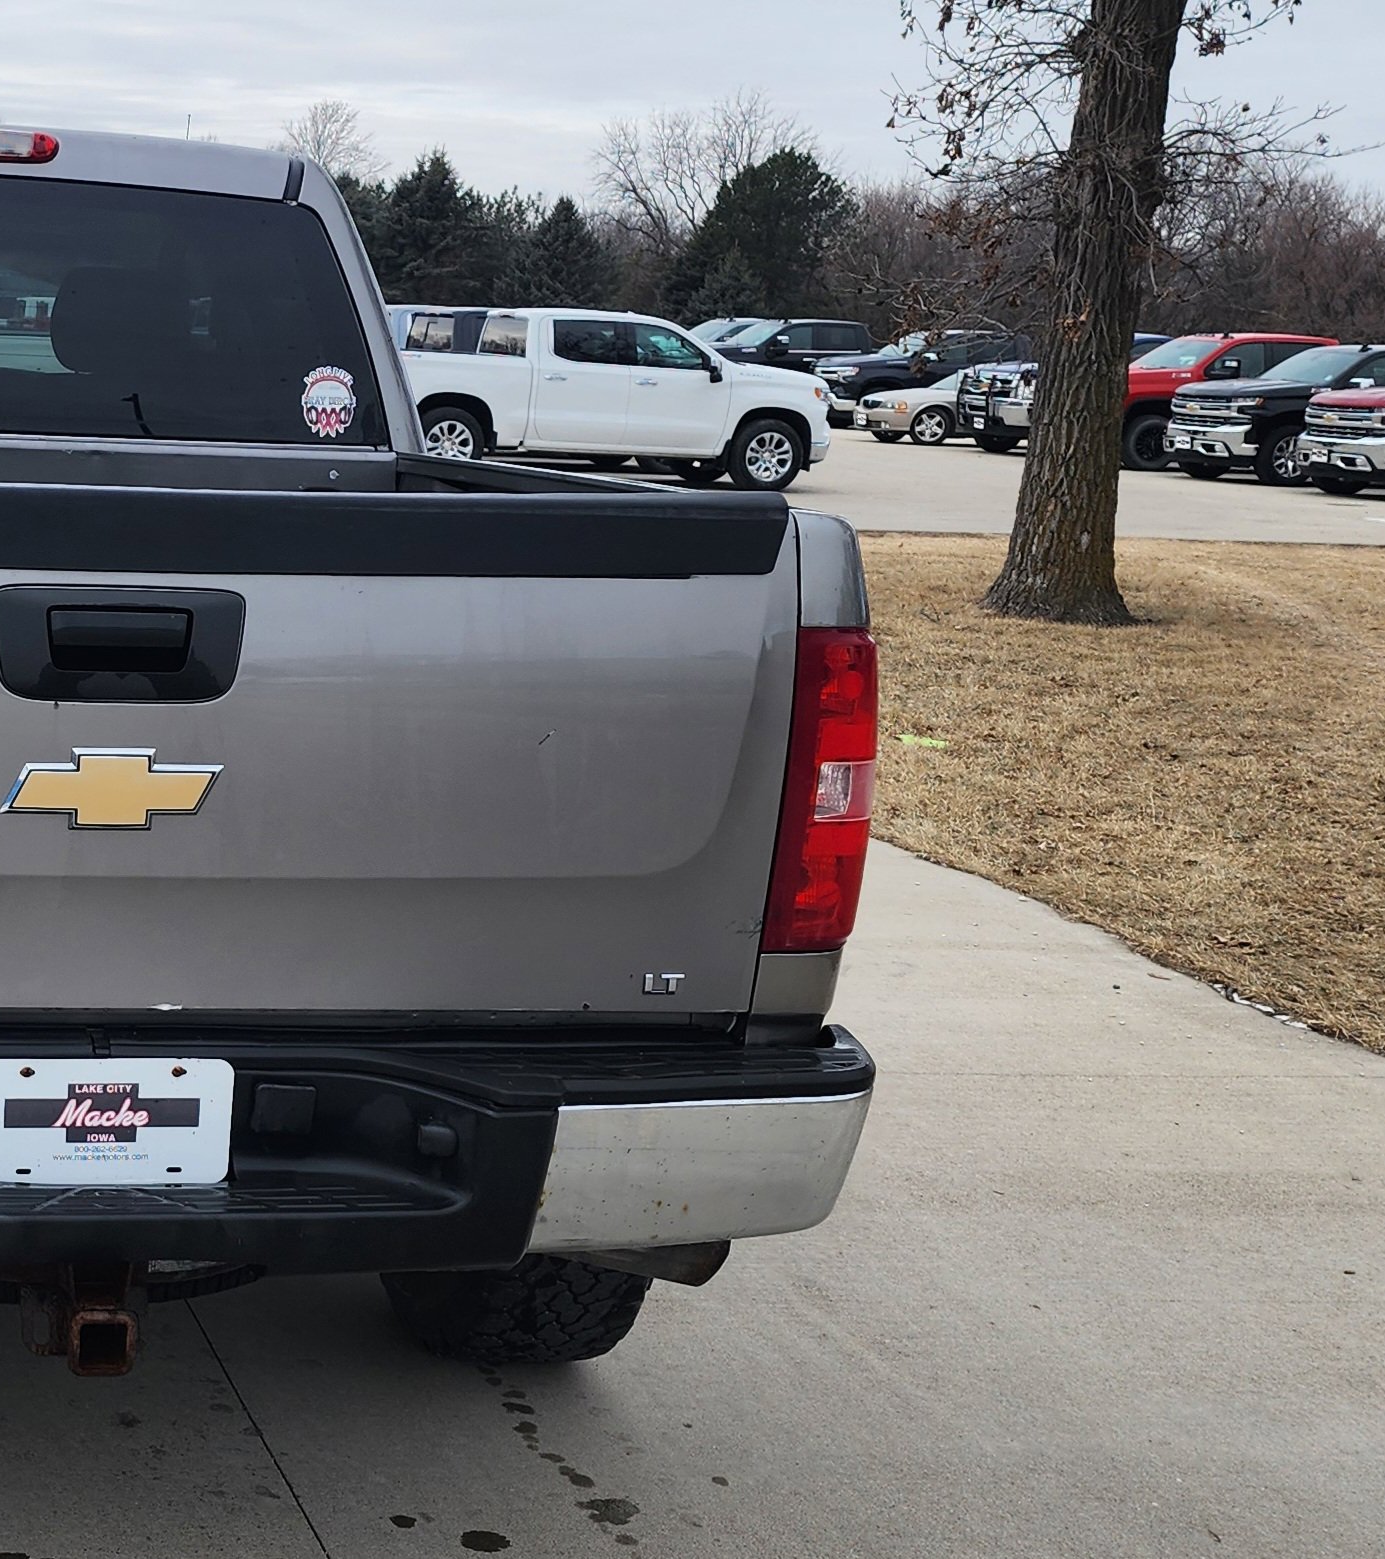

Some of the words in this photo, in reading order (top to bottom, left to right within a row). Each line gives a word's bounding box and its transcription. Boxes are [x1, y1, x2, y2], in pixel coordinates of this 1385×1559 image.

[642, 973, 686, 995] LT
[75, 1084, 104, 1094] LAKE
[106, 1084, 133, 1094] CITY
[51, 1096, 150, 1127] Macke
[86, 1133, 116, 1142] IOWA
